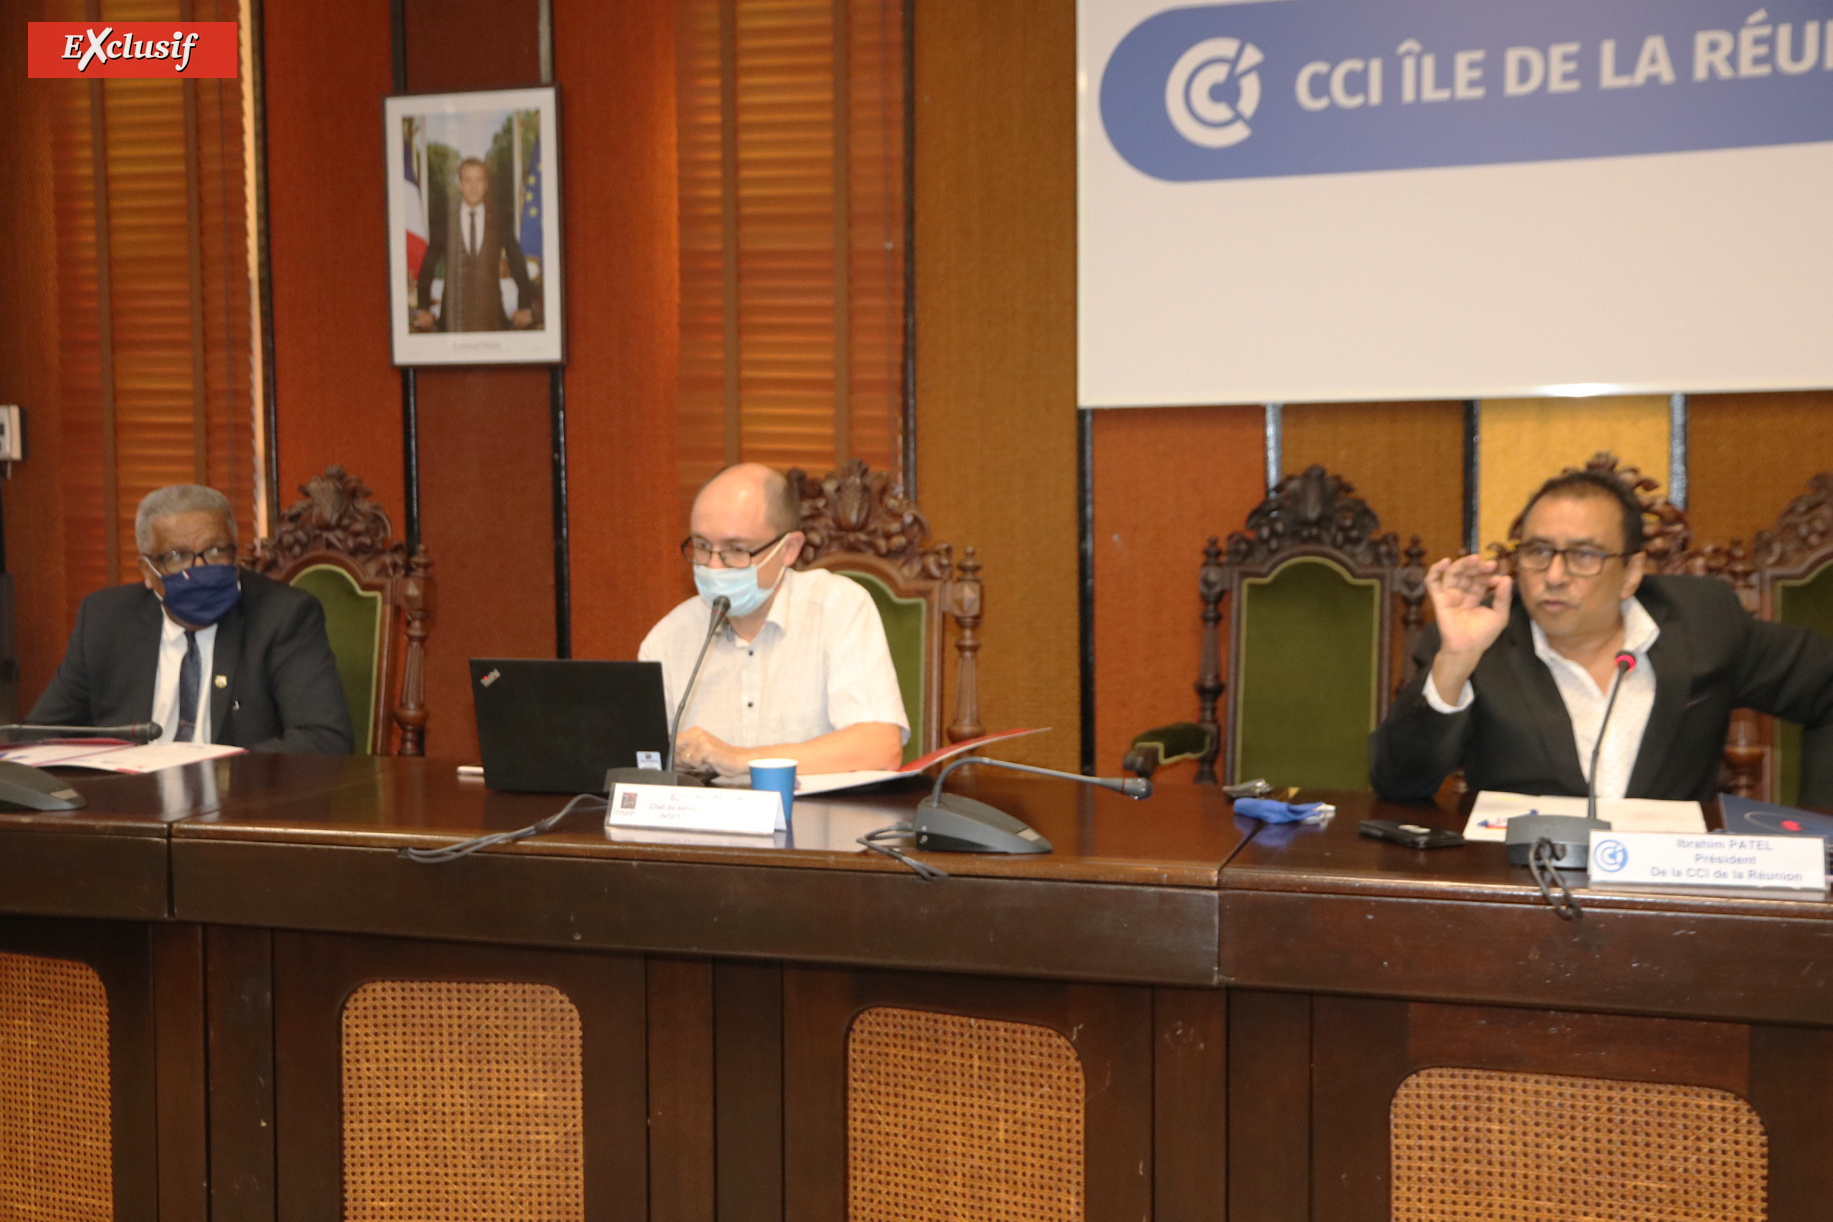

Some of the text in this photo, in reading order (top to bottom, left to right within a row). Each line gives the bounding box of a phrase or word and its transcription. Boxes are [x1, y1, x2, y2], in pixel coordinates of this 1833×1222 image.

[1295, 57, 1383, 111] CCI
[1396, 38, 1486, 103] ÎLE
[1503, 41, 1581, 96] DE
[1600, 34, 1676, 89] LA
[1676, 838, 1774, 851] Ibrahim PATEL
[1694, 853, 1757, 865] Président
[1650, 866, 1804, 882] De la CCI de la Réunion
